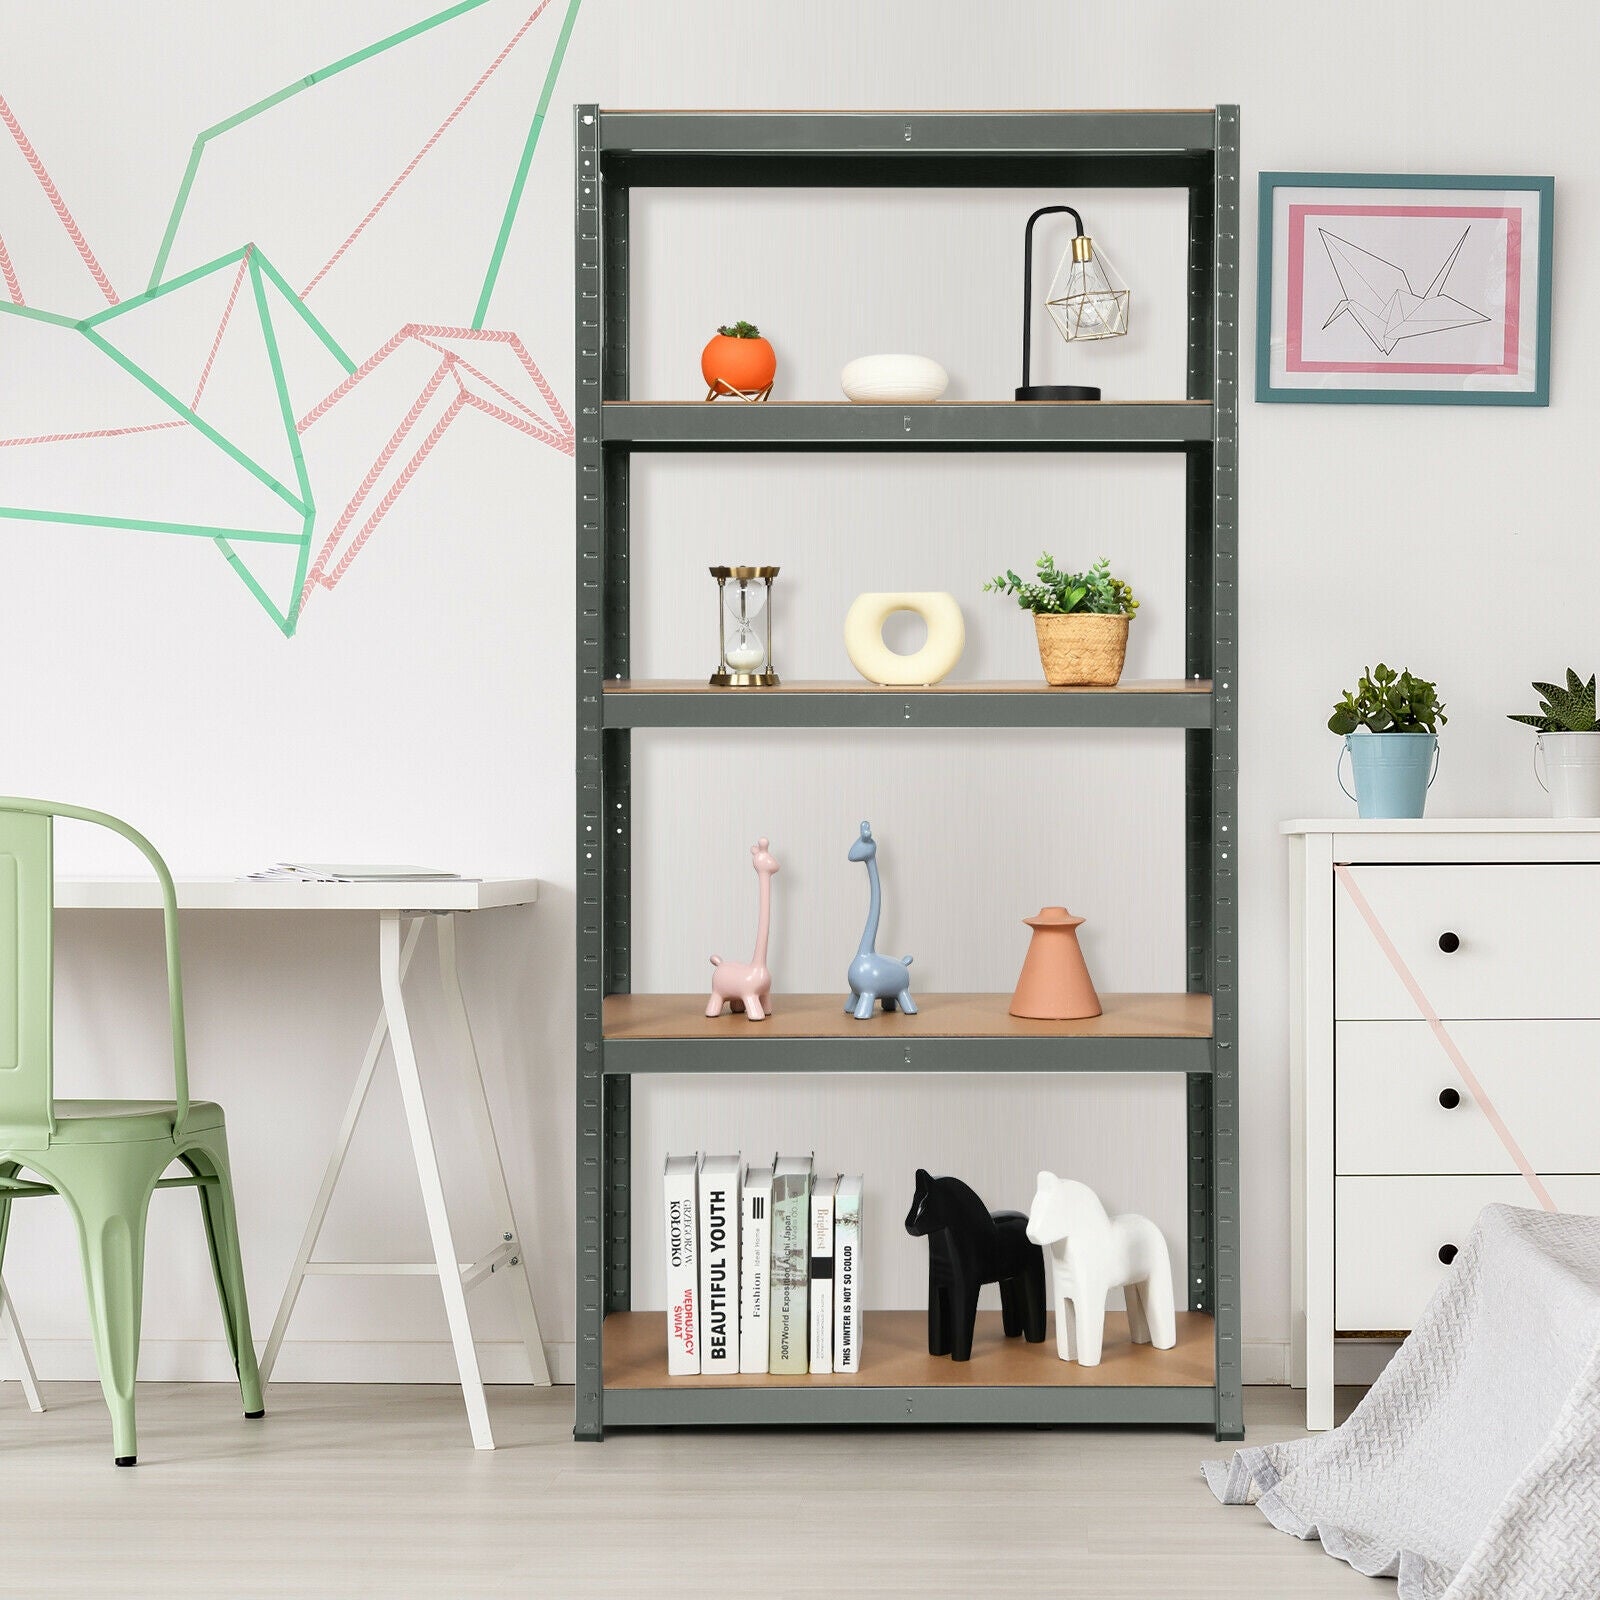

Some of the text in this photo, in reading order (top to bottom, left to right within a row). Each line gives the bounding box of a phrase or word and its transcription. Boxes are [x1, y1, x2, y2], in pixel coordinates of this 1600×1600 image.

[670, 1201, 681, 1267] KOŁODKO
[684, 1199, 692, 1254] GRZEGORZ
[784, 1215, 792, 1240] Japan
[816, 1208, 829, 1250] Brightest
[710, 1191, 726, 1359] BEAUTIFUL YOUTH
[844, 1245, 852, 1271] COLOD
[753, 1272, 761, 1318] Fashion
[844, 1275, 851, 1285] SO
[674, 1306, 682, 1339] ŚWIAT
[683, 1289, 694, 1355] WĘDRUJĄCY
[844, 1305, 851, 1313] IS
[843, 1315, 851, 1346] WINTER
